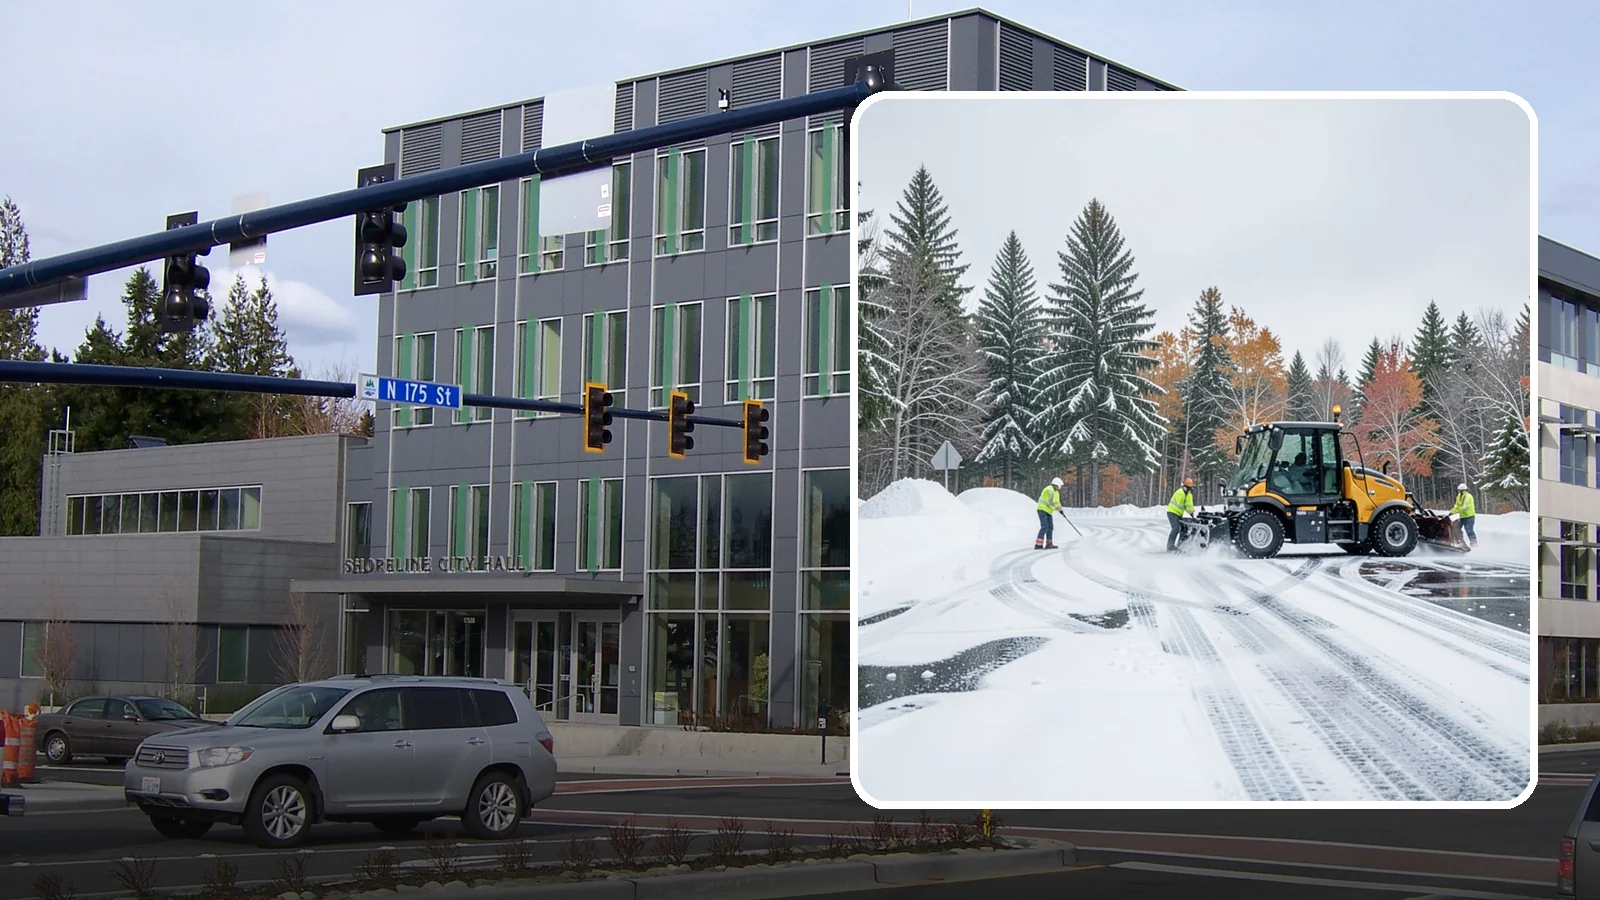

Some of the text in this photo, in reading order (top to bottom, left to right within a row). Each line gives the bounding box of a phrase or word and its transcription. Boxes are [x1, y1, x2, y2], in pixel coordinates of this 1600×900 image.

[387, 380, 451, 406] N 175 St
[343, 555, 526, 574] SHORELINE CITY HALL
